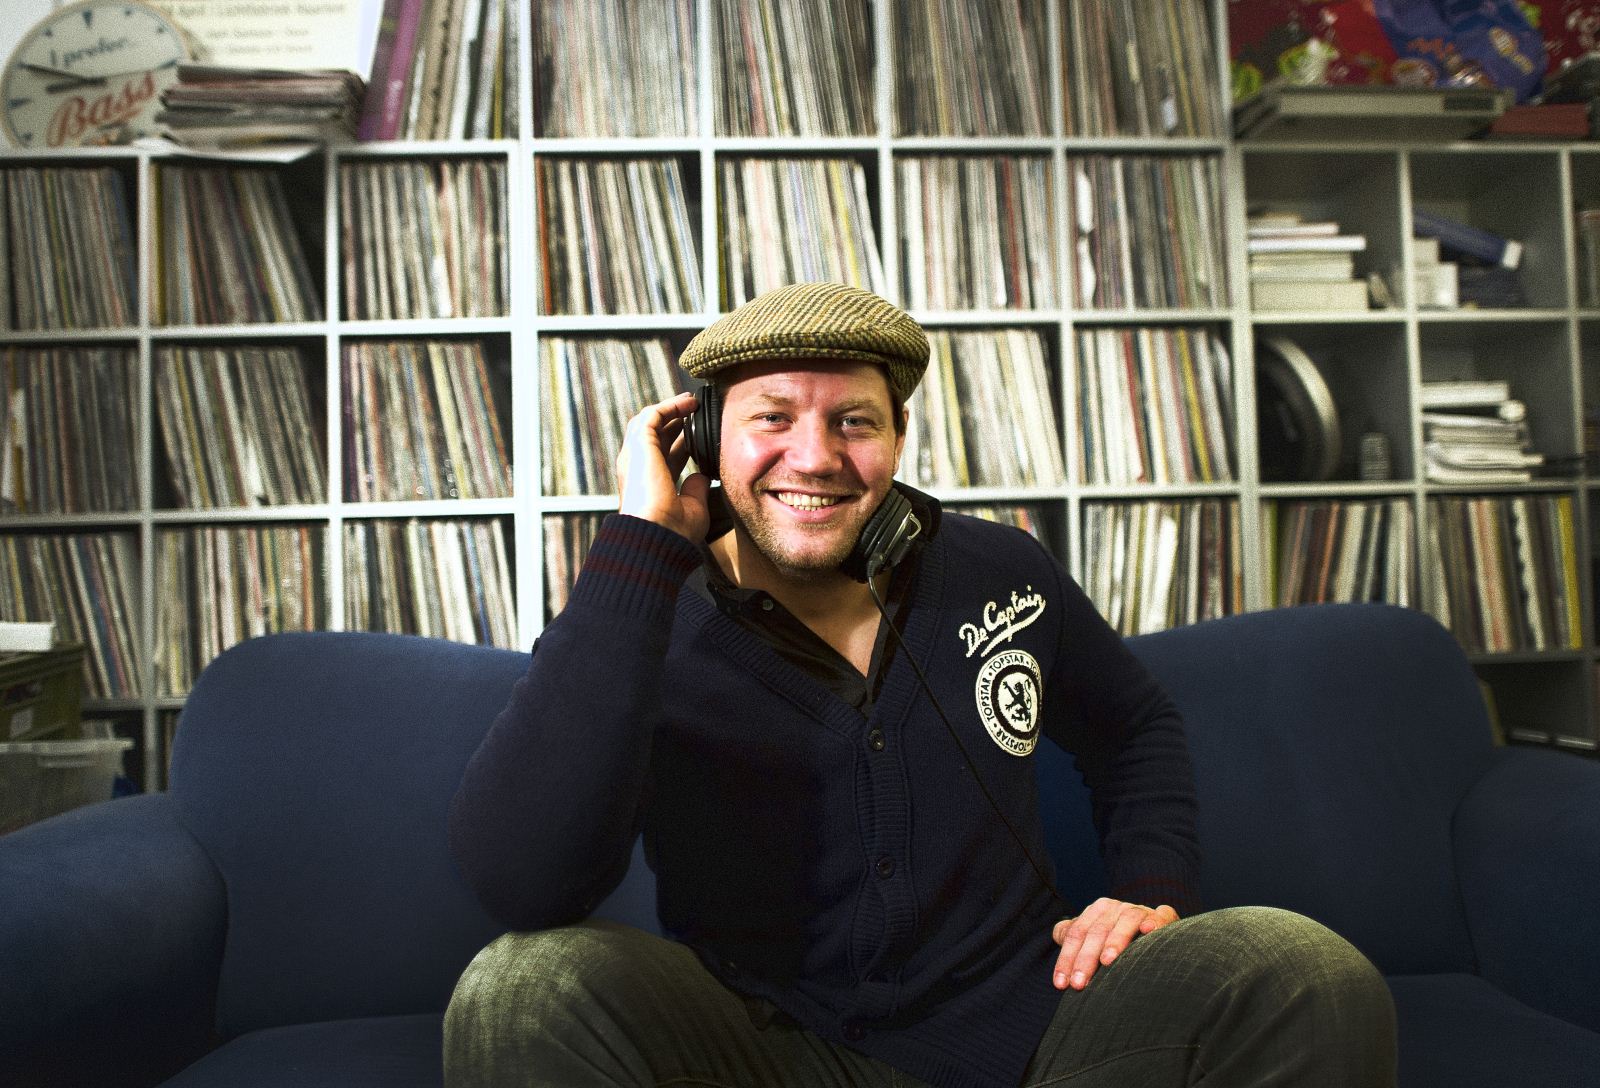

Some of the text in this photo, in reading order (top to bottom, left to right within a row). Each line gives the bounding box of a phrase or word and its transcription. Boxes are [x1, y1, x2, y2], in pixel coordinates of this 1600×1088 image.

[47, 70, 156, 147] Bass
[959, 585, 1046, 658] De Captain
[980, 654, 1027, 752] TOPSTAR TOPSTAR TOPSTAR
